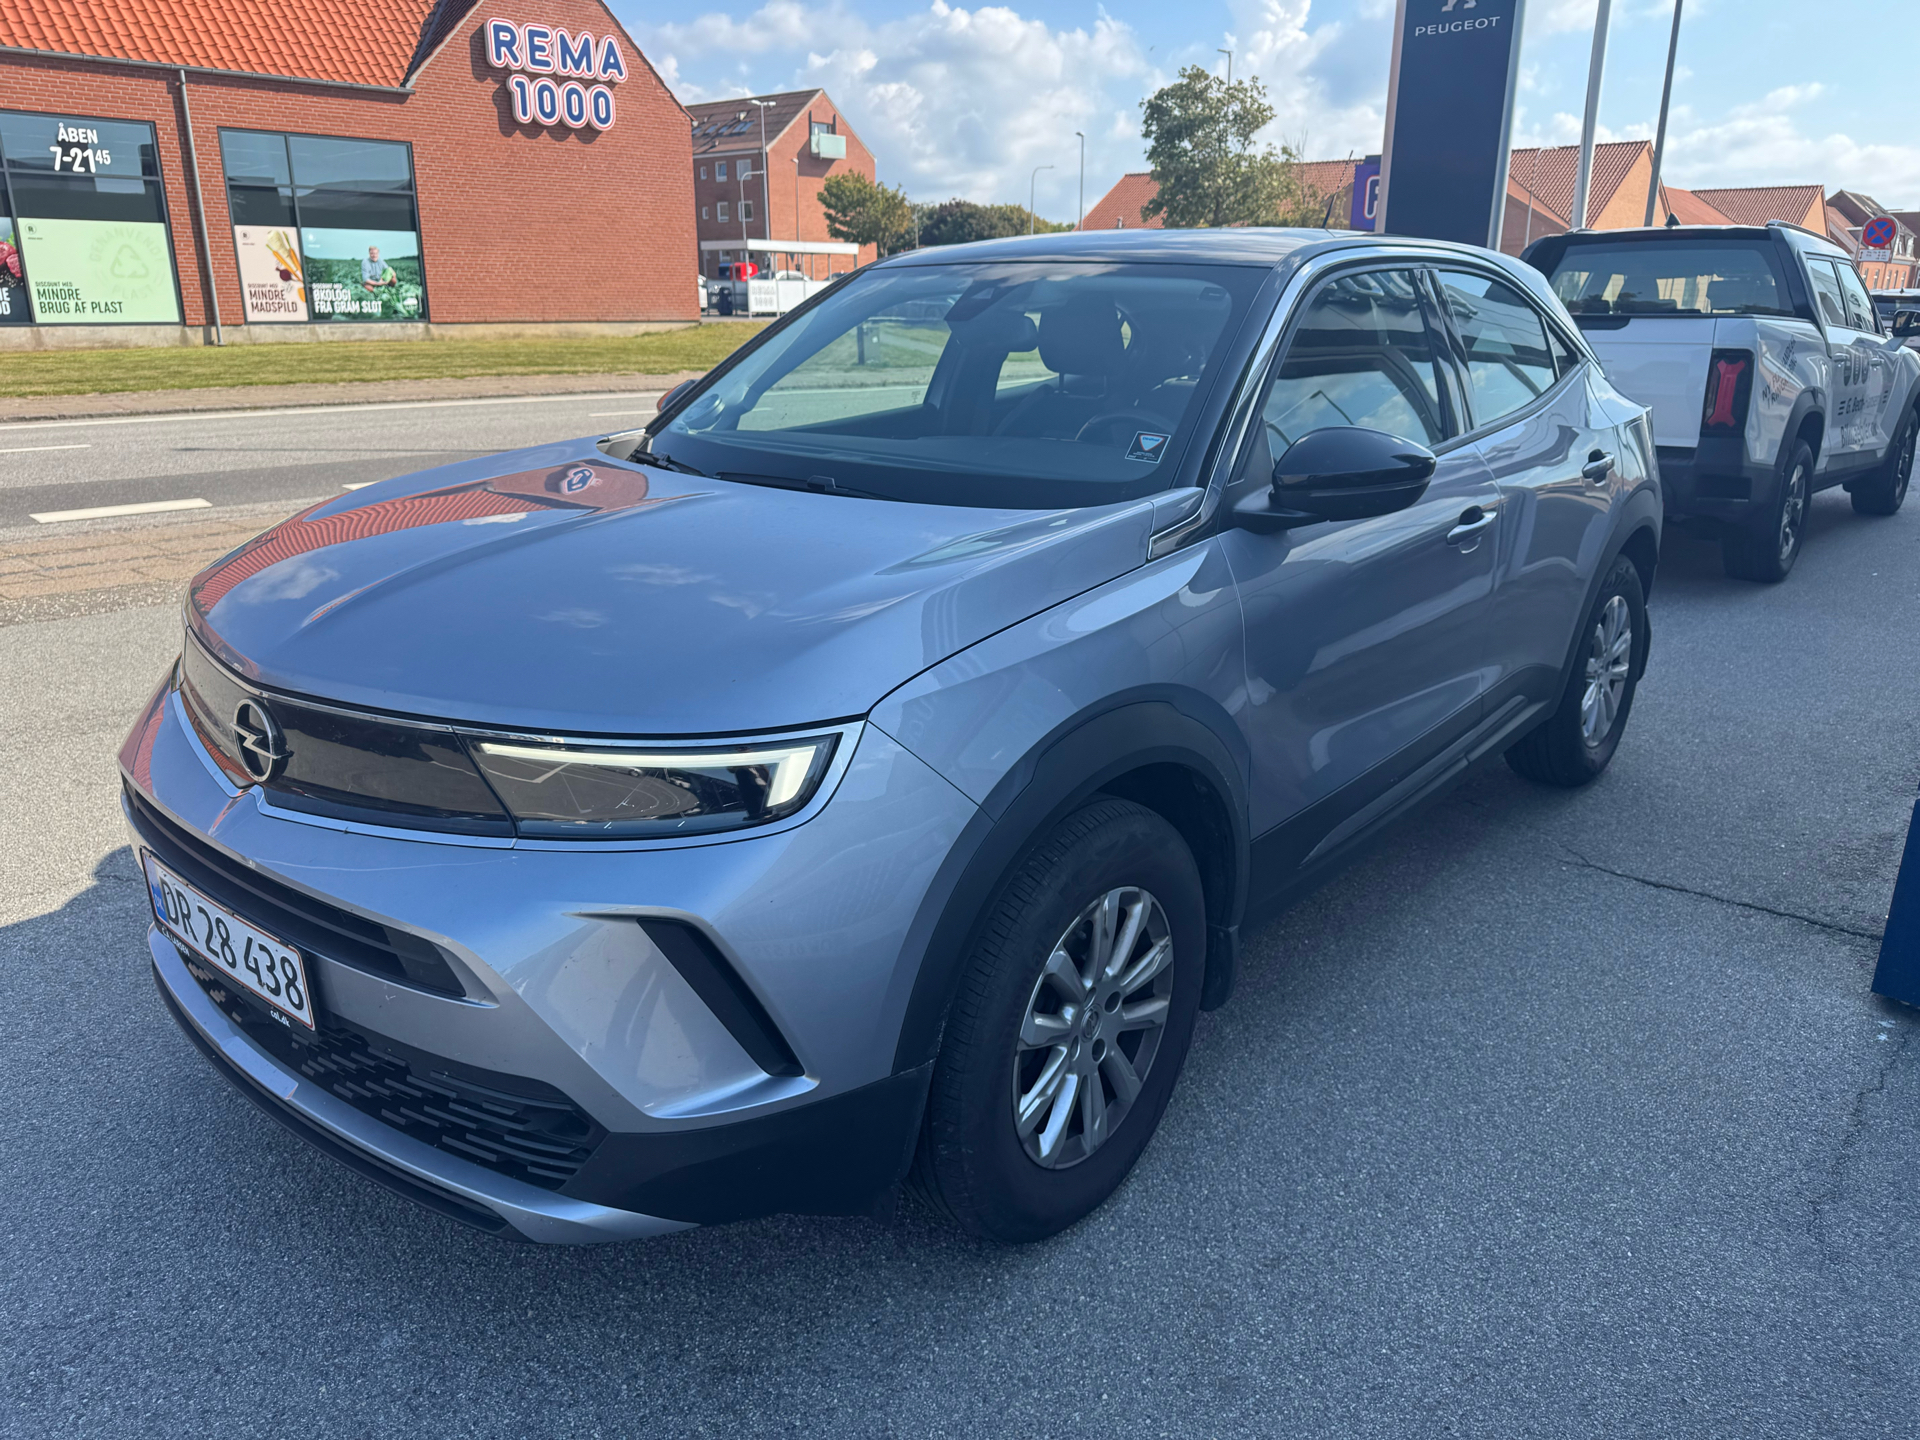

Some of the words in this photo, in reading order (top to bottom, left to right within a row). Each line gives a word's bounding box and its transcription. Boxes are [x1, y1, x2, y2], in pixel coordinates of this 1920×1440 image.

[1415, 16, 1500, 37] PEUGEOT
[486, 18, 628, 83] REMA
[507, 74, 616, 131] 1000
[57, 122, 98, 145] ÅBEN
[37, 288, 81, 301] MINDRE
[249, 289, 286, 301] MINDRE
[313, 288, 351, 301] ØKOLOGI
[40, 301, 70, 314] BRUG
[74, 301, 86, 314] AF
[91, 301, 123, 314] PLAST
[251, 301, 298, 314] MADSPILD
[315, 301, 333, 314] FRA
[334, 301, 360, 314] GRAM
[361, 301, 383, 313] SLOT
[159, 876, 199, 943] DR
[197, 904, 237, 969] 28
[244, 935, 305, 1011] 438
[270, 1009, 291, 1028] cal.dk
